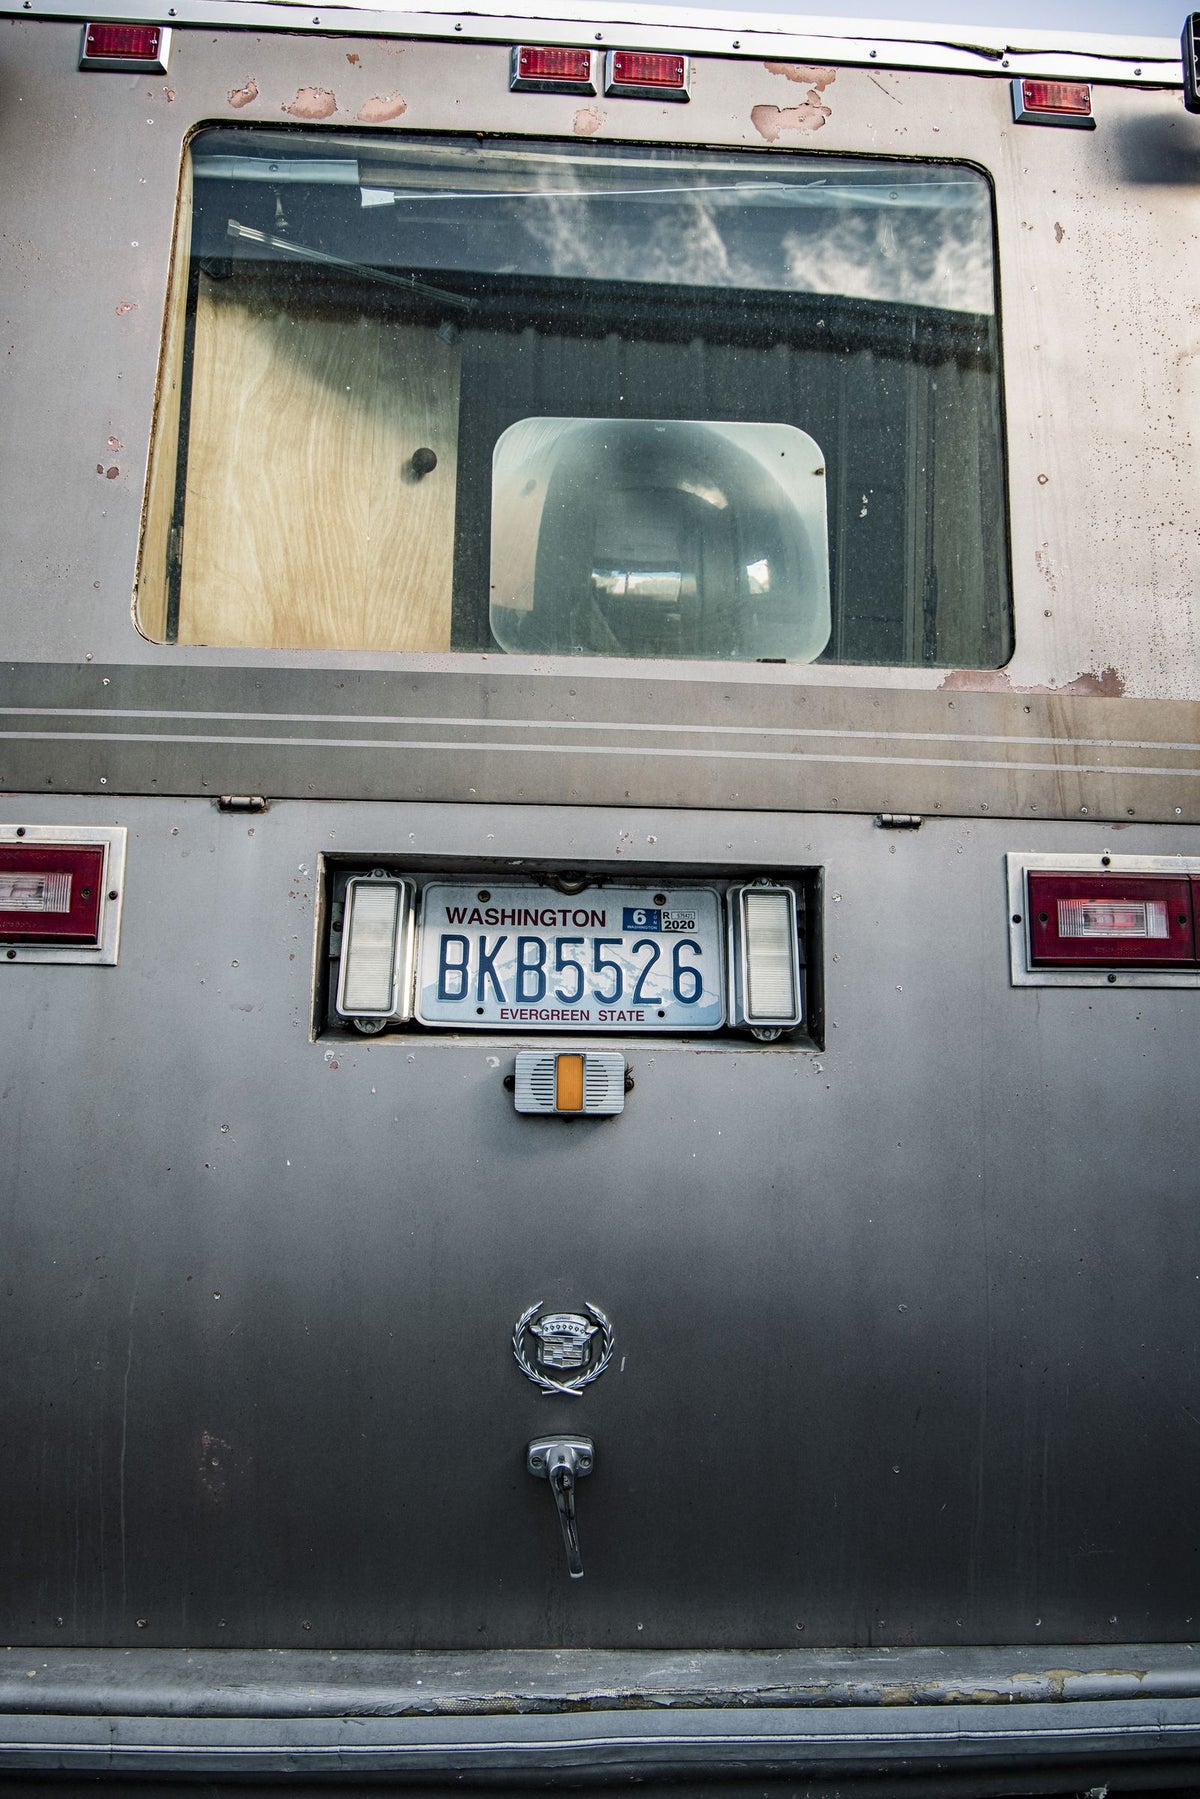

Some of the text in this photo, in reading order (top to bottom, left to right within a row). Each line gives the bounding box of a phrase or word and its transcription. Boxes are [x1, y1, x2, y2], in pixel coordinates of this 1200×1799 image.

[445, 906, 606, 928] WASHINGTON
[633, 909, 646, 925] 6
[663, 911, 670, 919] R
[664, 920, 695, 929] 2020
[438, 934, 703, 1004] BKB5526
[499, 1007, 646, 1023] EVERGREEN STATE
